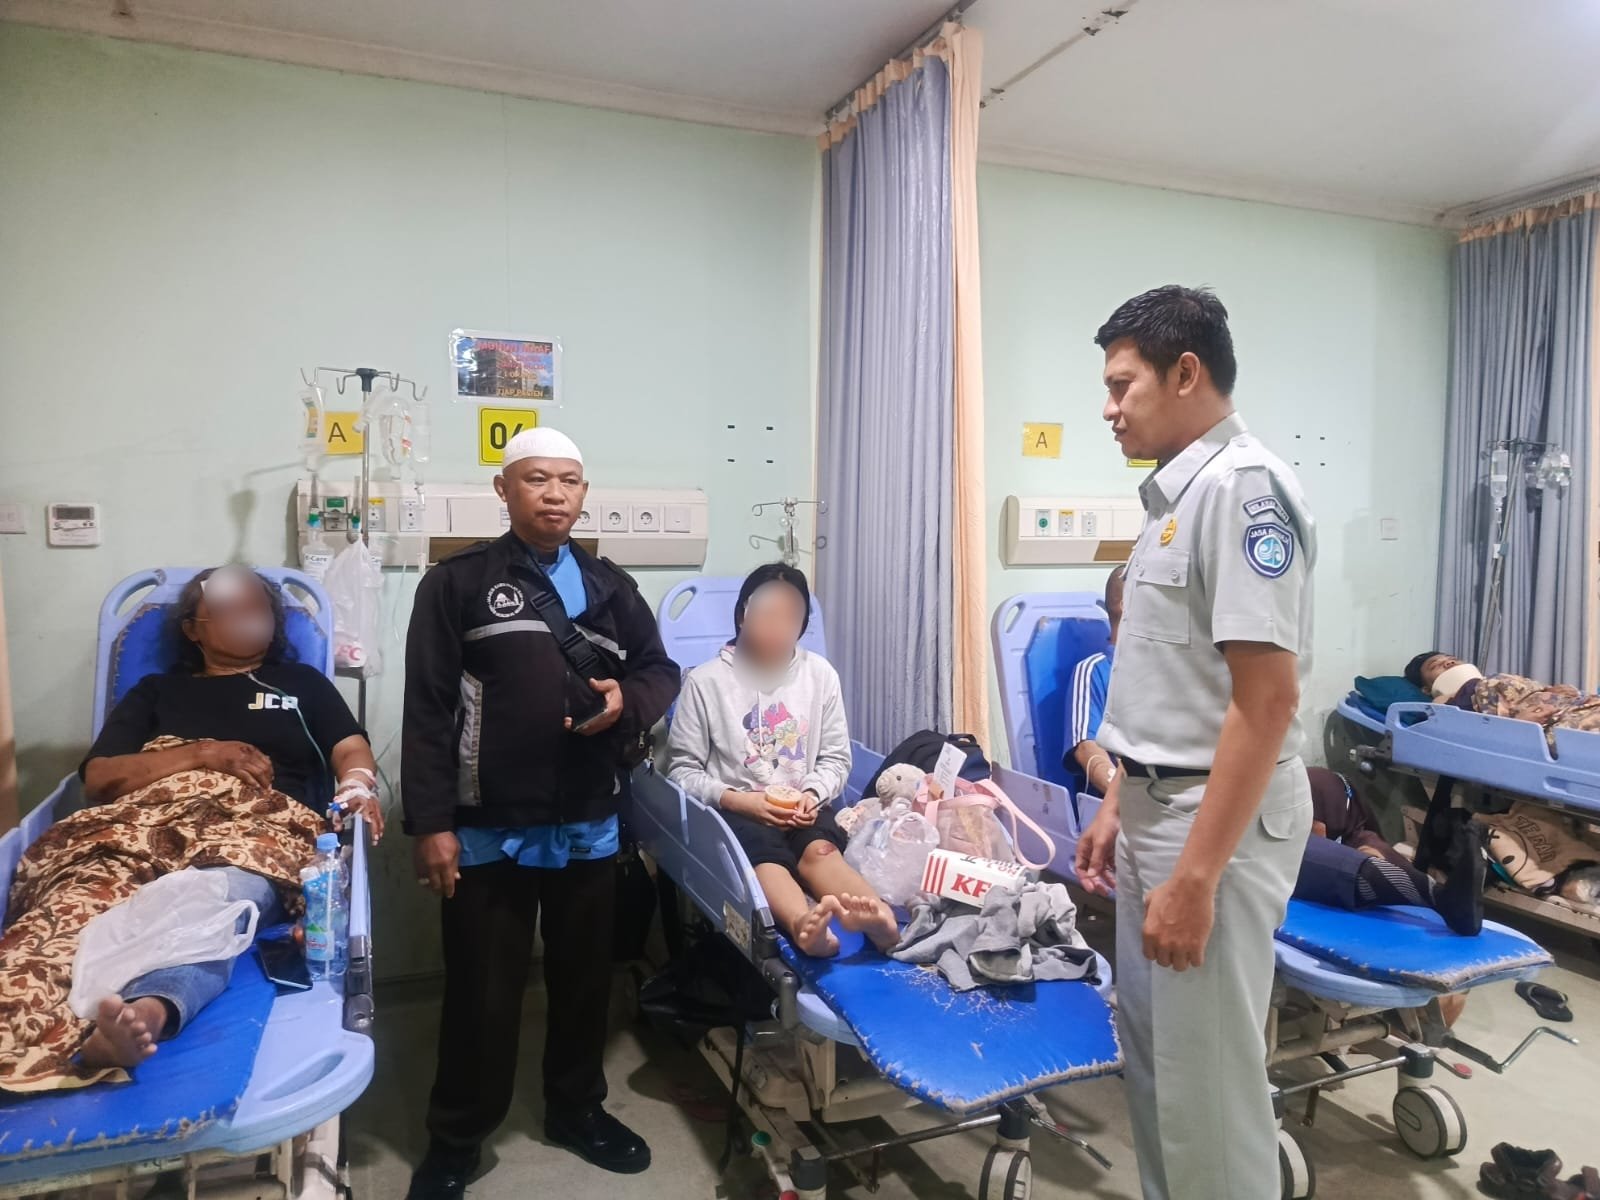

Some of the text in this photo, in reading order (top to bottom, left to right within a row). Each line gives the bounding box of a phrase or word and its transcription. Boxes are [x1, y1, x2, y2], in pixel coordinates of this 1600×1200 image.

[328, 422, 347, 443] A
[1035, 431, 1048, 448] A
[1250, 529, 1266, 538] JASA
[951, 873, 993, 898] KF
